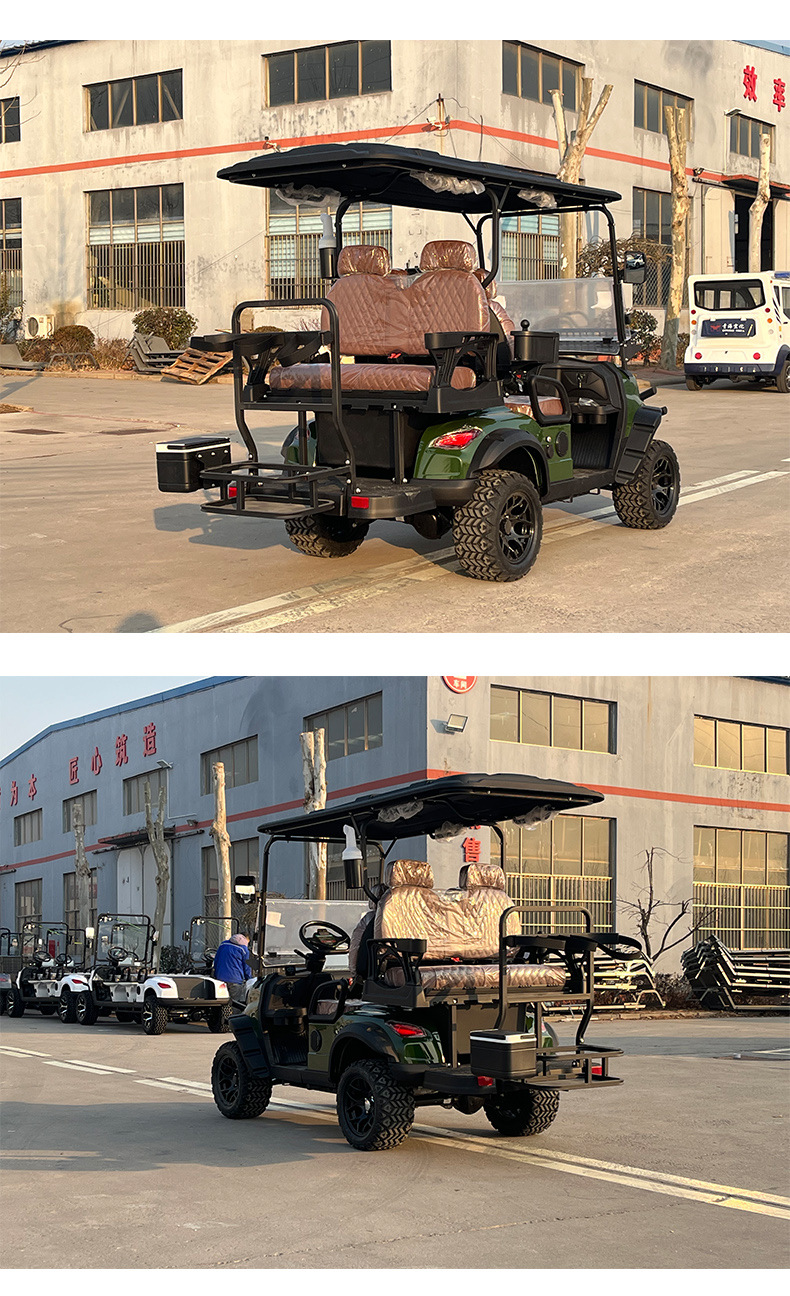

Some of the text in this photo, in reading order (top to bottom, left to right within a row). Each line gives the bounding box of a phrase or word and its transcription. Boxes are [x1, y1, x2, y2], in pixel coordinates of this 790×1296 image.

[743, 65, 786, 113] 效率
[0, 722, 157, 801] 为本 匠心筑造
